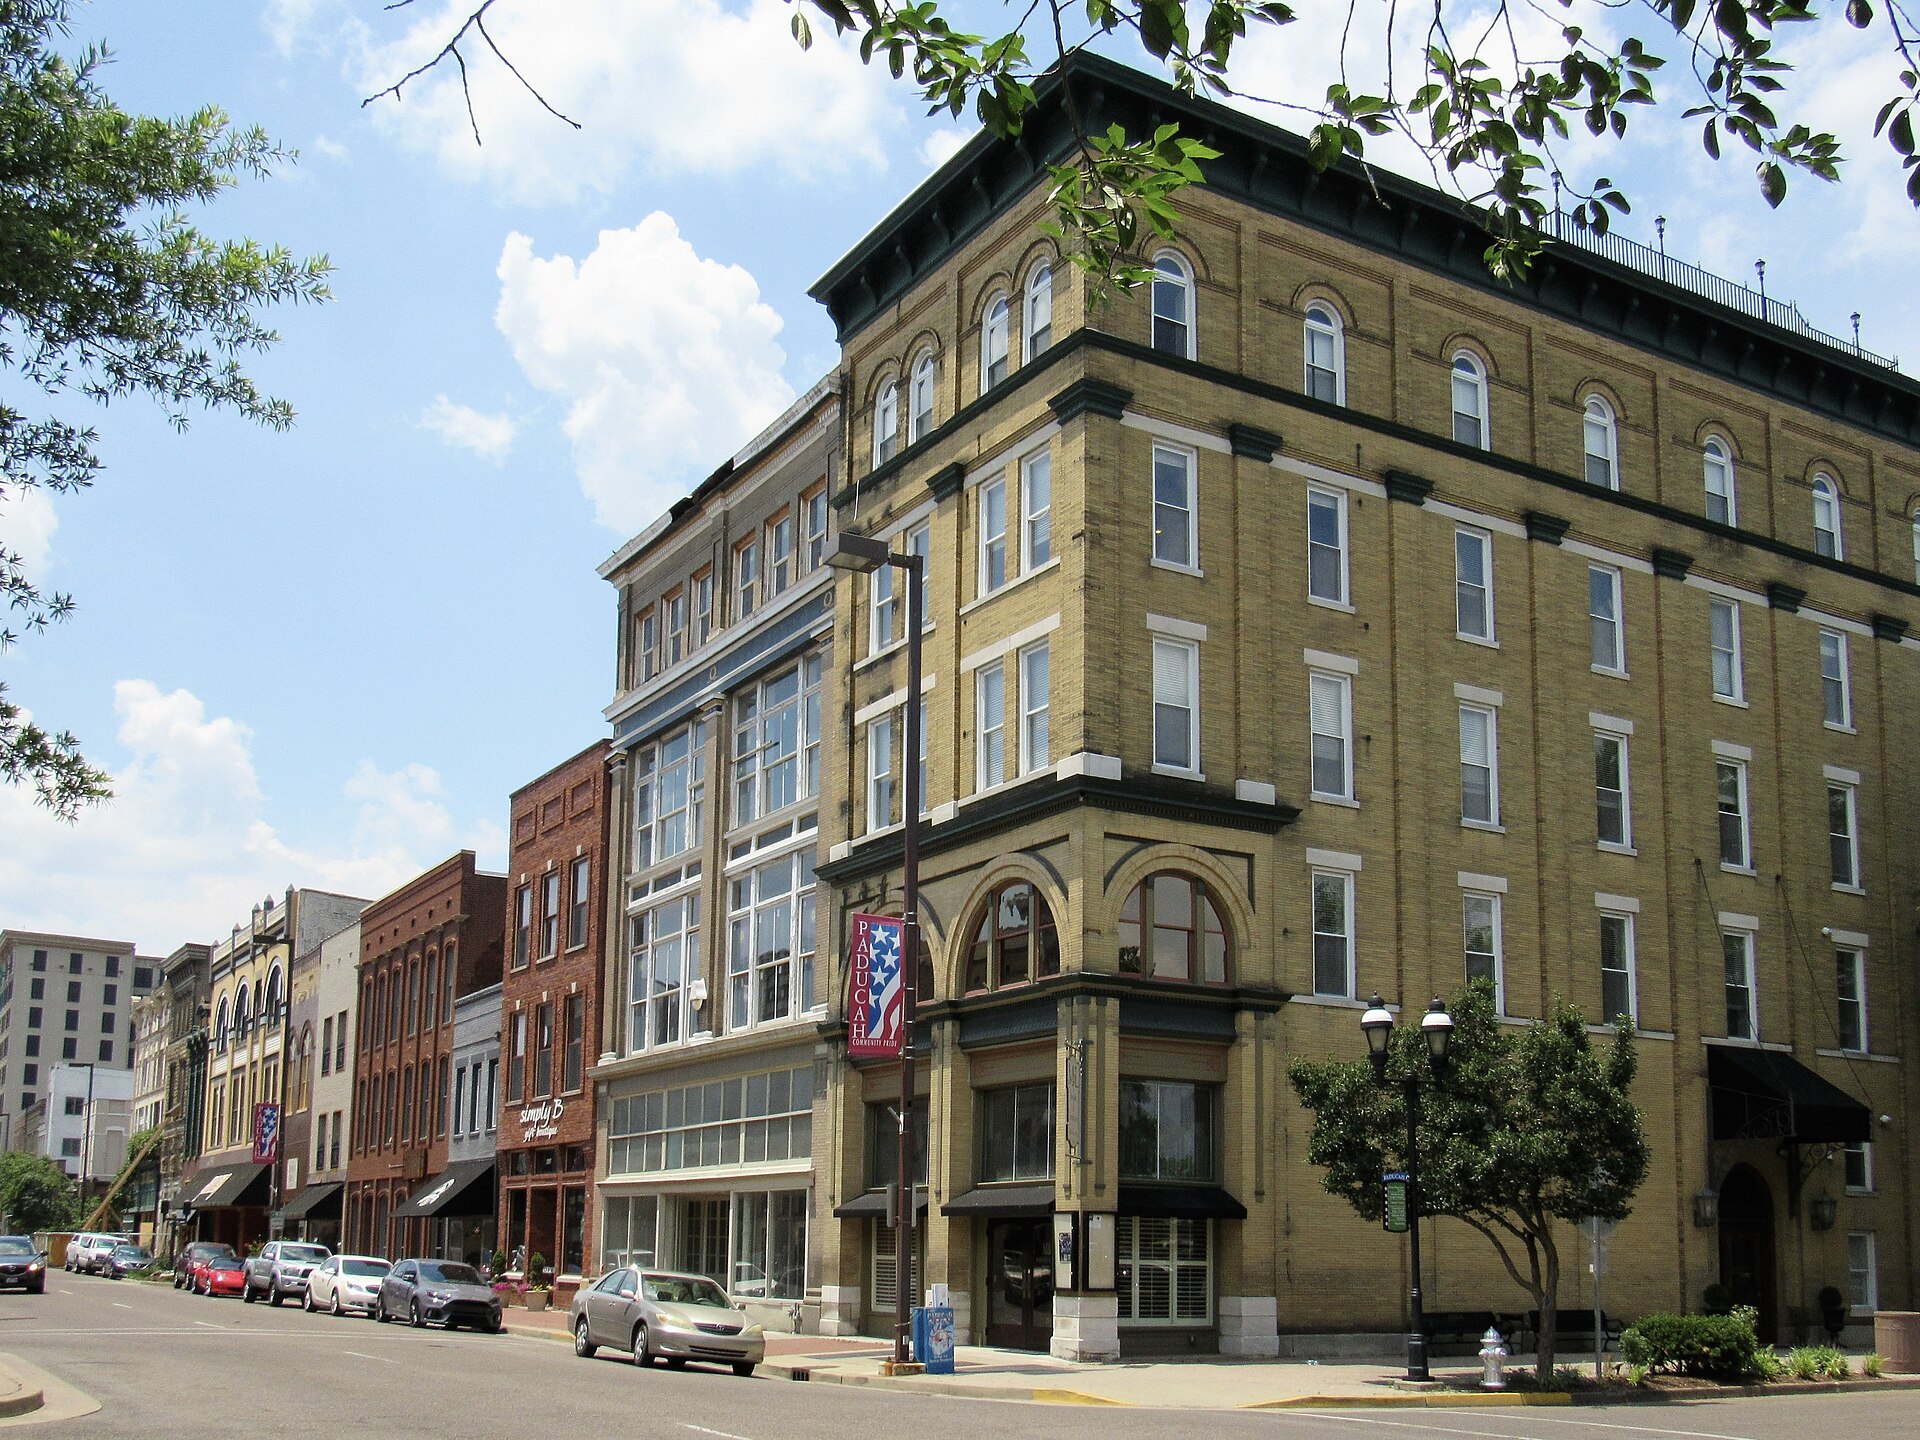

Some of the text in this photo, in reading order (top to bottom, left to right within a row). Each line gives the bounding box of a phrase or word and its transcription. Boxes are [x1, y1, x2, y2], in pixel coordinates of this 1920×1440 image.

[852, 921, 869, 1038] PADUCAH
[852, 1039, 881, 1047] COMMUNITY
[255, 1106, 263, 1156] PADUCAH
[520, 1099, 564, 1128] simply B
